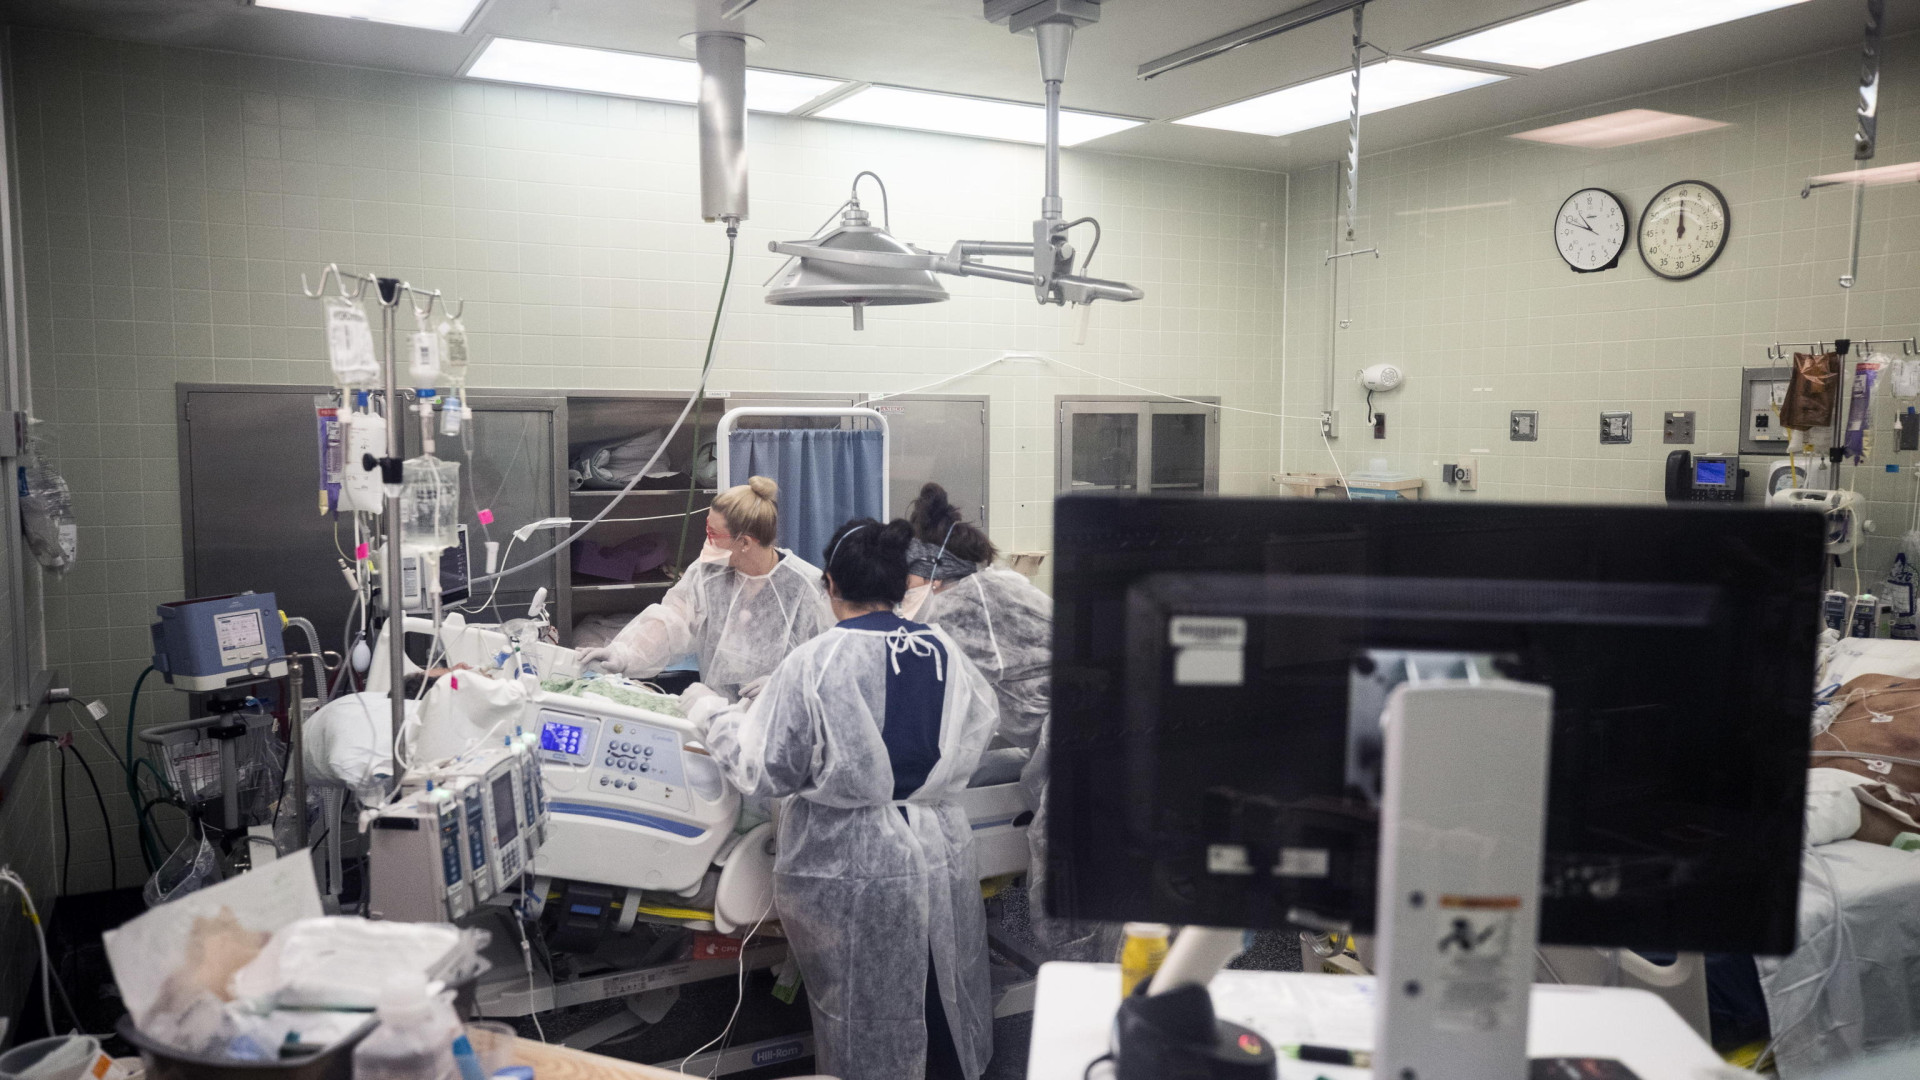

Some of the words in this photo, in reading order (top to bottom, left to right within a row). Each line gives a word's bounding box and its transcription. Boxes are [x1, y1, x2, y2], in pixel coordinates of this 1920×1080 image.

[1679, 189, 1688, 197] 60
[1697, 193, 1701, 201] 5
[1711, 222, 1718, 230] 15
[1646, 230, 1654, 238] 45
[1705, 240, 1714, 248] 20
[1649, 246, 1658, 255] 40
[1660, 258, 1668, 266] 35
[1692, 255, 1701, 263] 25
[1675, 261, 1684, 269] 30
[757, 1047, 798, 1062] Hill-Rom
